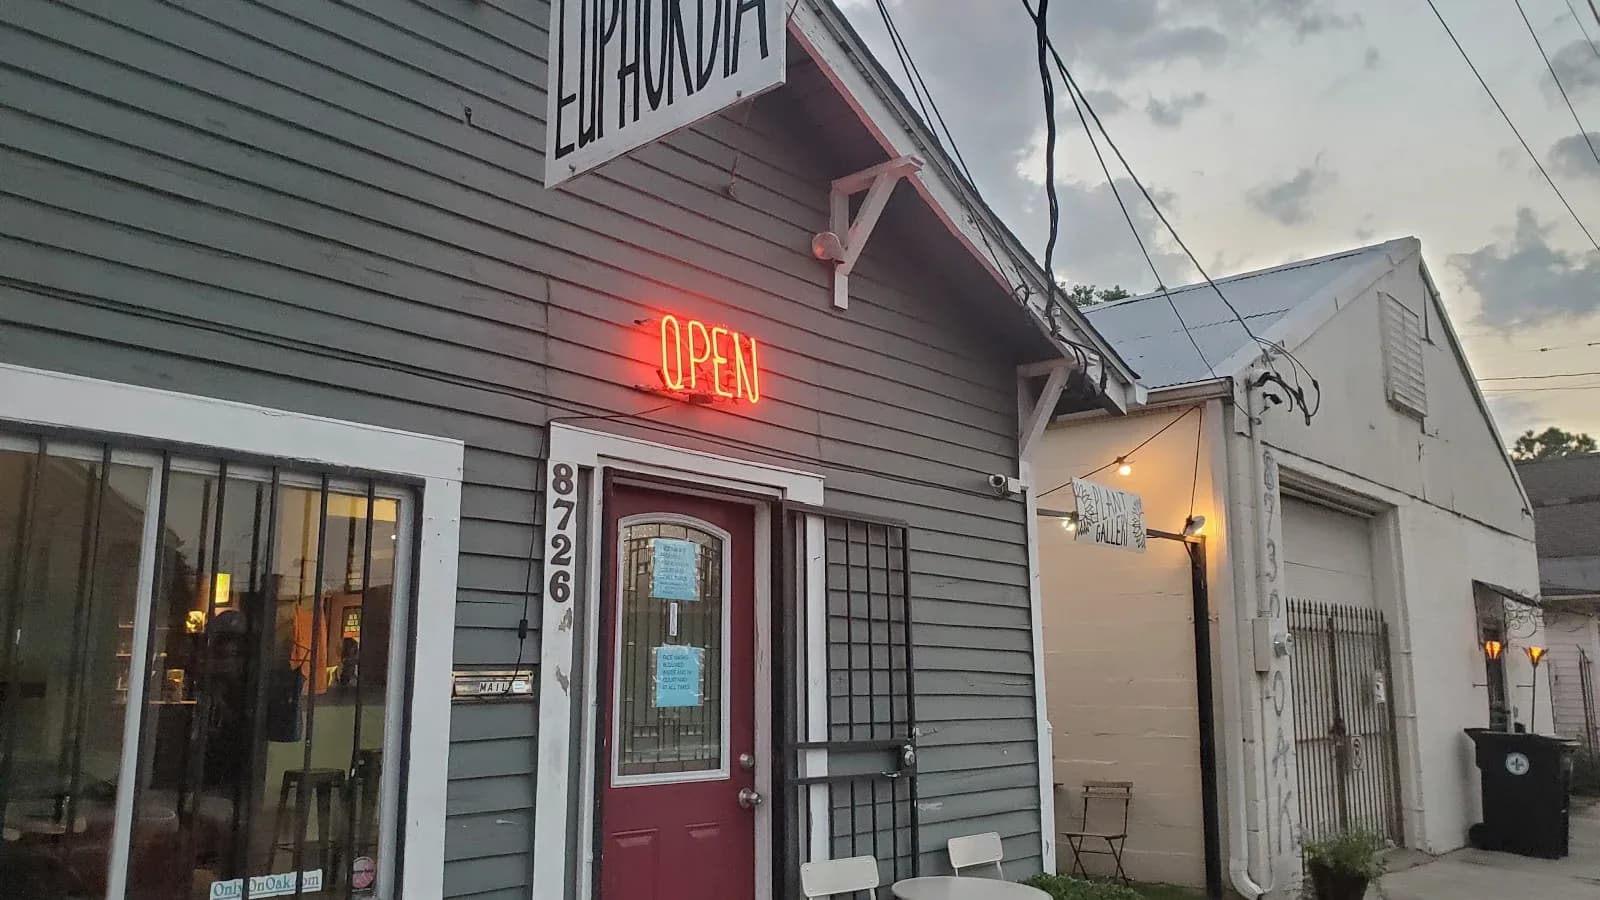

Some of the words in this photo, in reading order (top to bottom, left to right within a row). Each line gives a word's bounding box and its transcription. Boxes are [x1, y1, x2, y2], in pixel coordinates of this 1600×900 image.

[661, 314, 759, 404] OPEN
[549, 462, 575, 603] 8726
[479, 682, 508, 692] MAIL
[212, 875, 319, 898] OnlyOnOak.om
